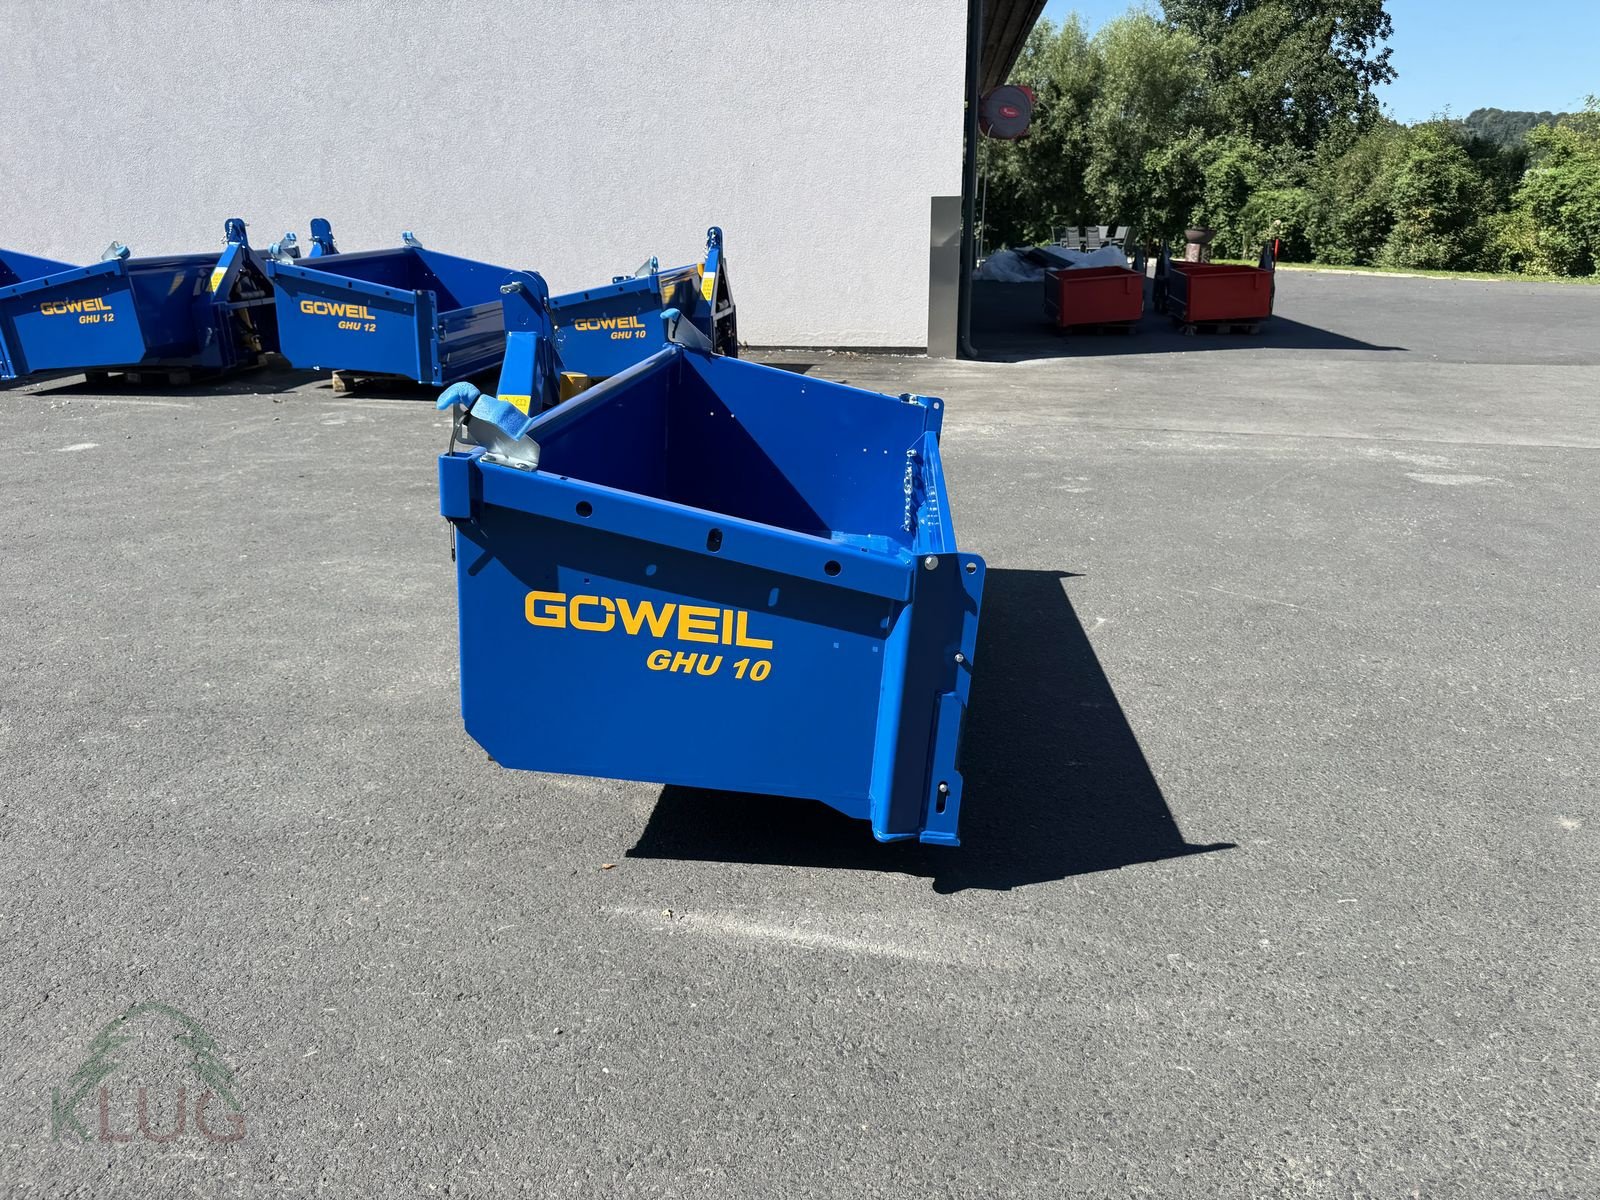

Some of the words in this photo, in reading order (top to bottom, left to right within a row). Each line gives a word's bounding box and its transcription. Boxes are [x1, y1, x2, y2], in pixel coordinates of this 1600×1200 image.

[79, 314, 101, 324] GHU
[103, 313, 114, 322] 12
[338, 320, 362, 331] GHU
[364, 323, 376, 333] 12
[611, 331, 632, 340] GHU
[635, 330, 646, 339] 10
[646, 649, 723, 677] GHU
[733, 657, 772, 682] 10
